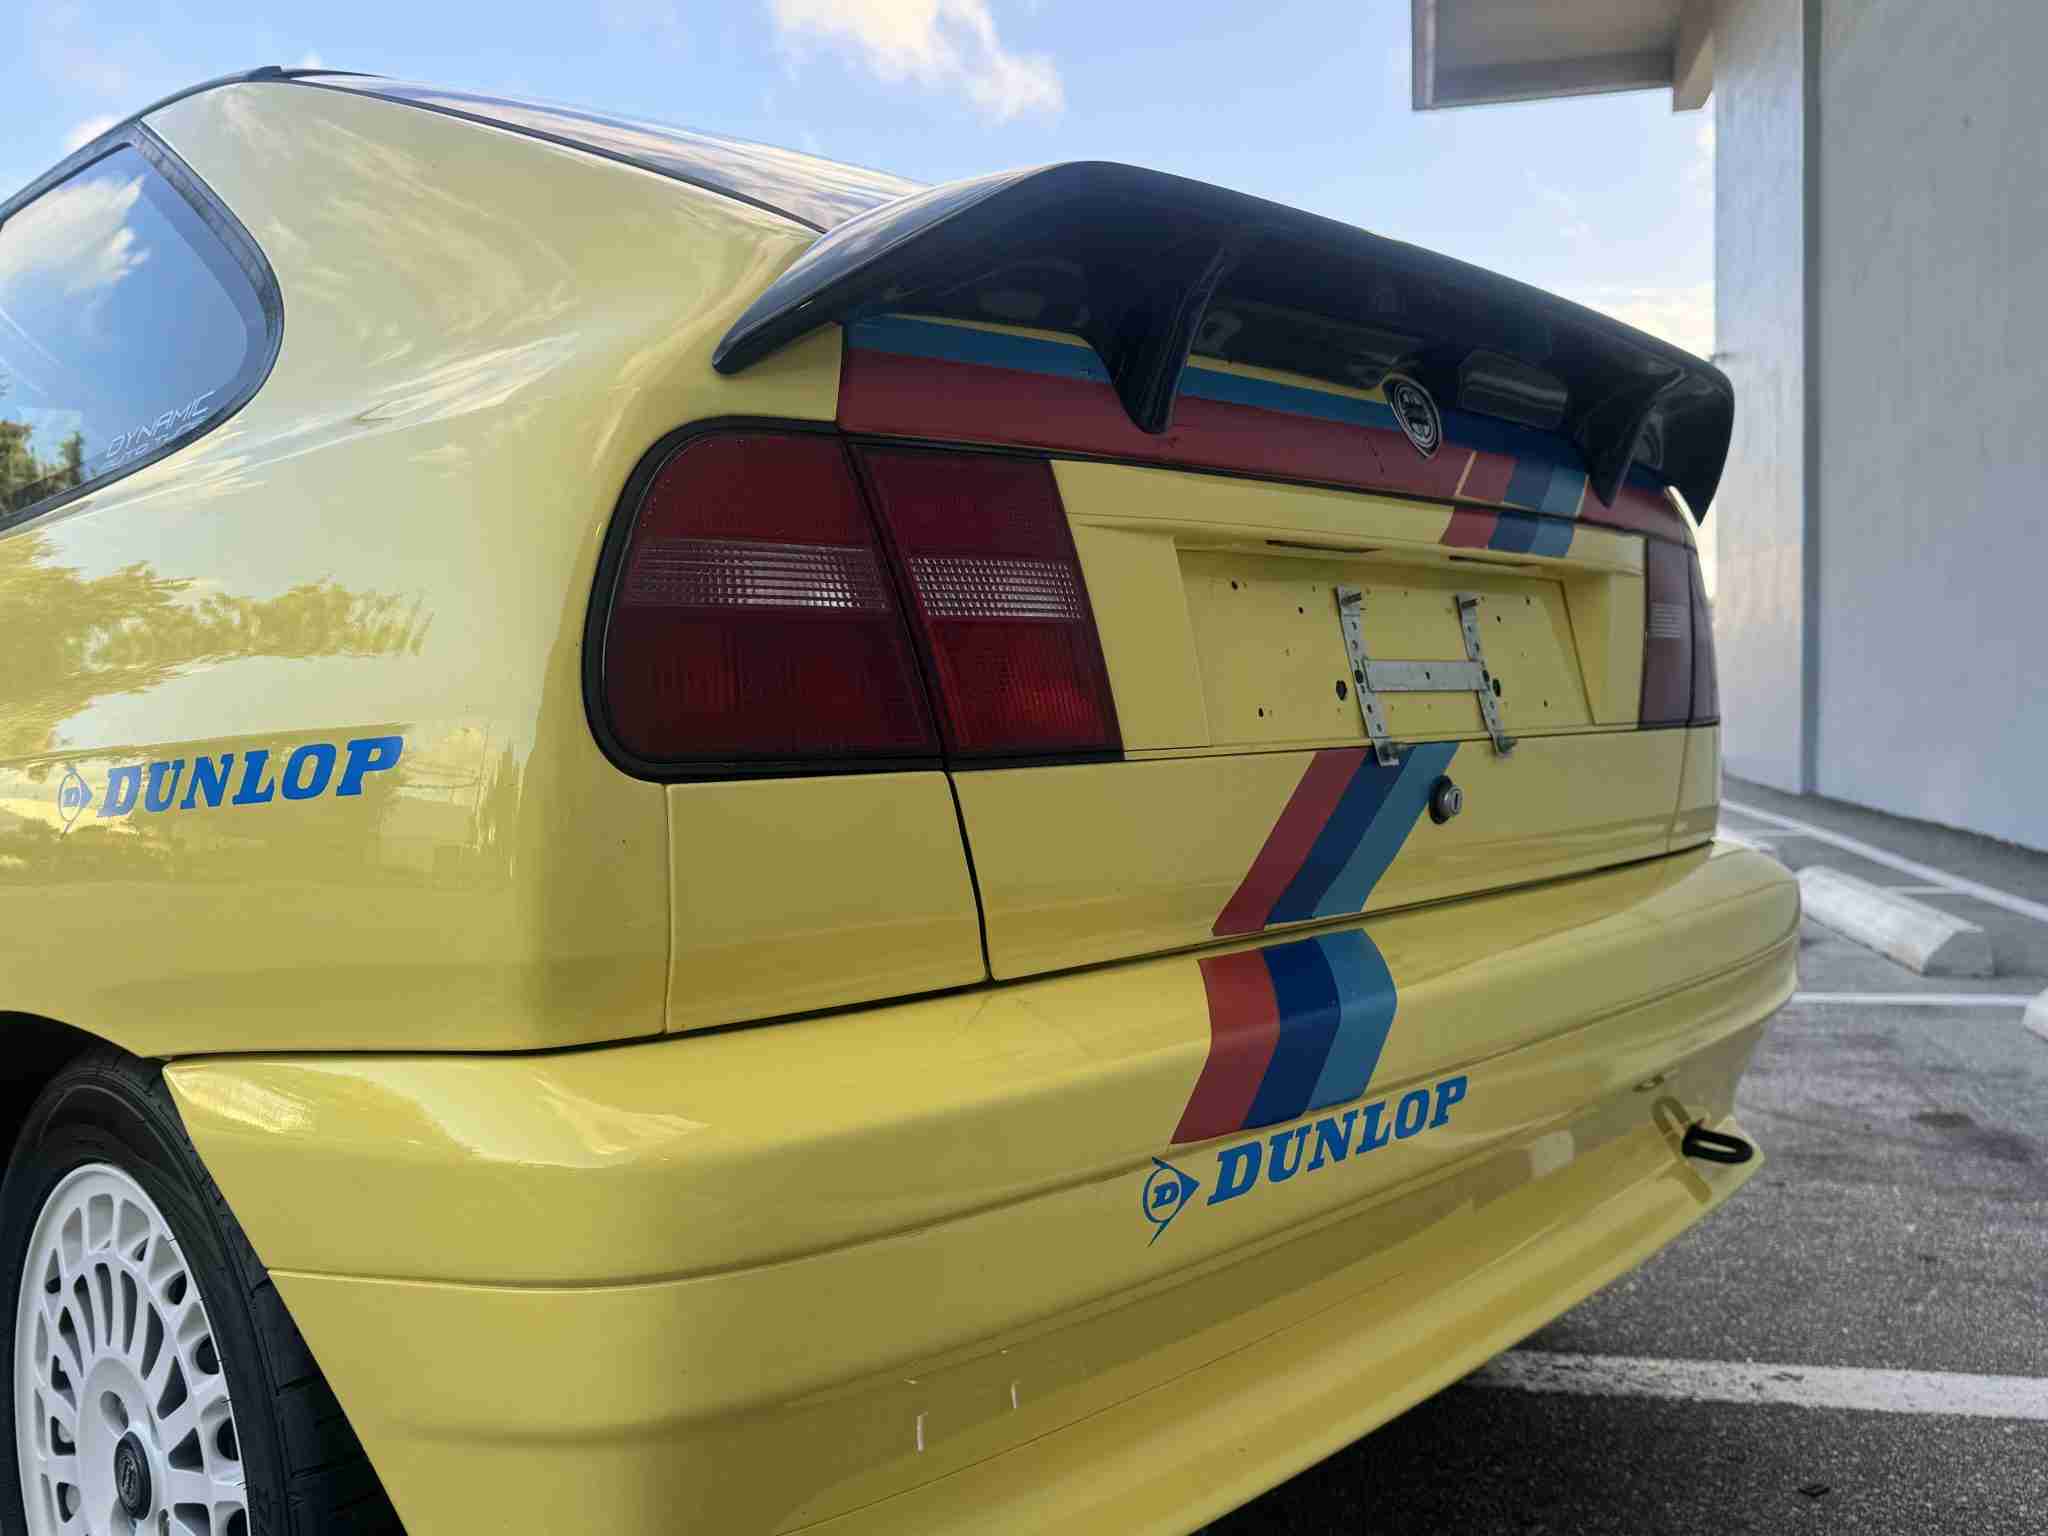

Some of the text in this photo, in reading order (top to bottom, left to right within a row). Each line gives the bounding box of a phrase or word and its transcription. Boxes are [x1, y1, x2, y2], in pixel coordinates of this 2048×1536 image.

[106, 390, 216, 458] DYNAMIC
[97, 735, 403, 818] DUNLOP
[1152, 1075, 1468, 1208] D DUNLOP
